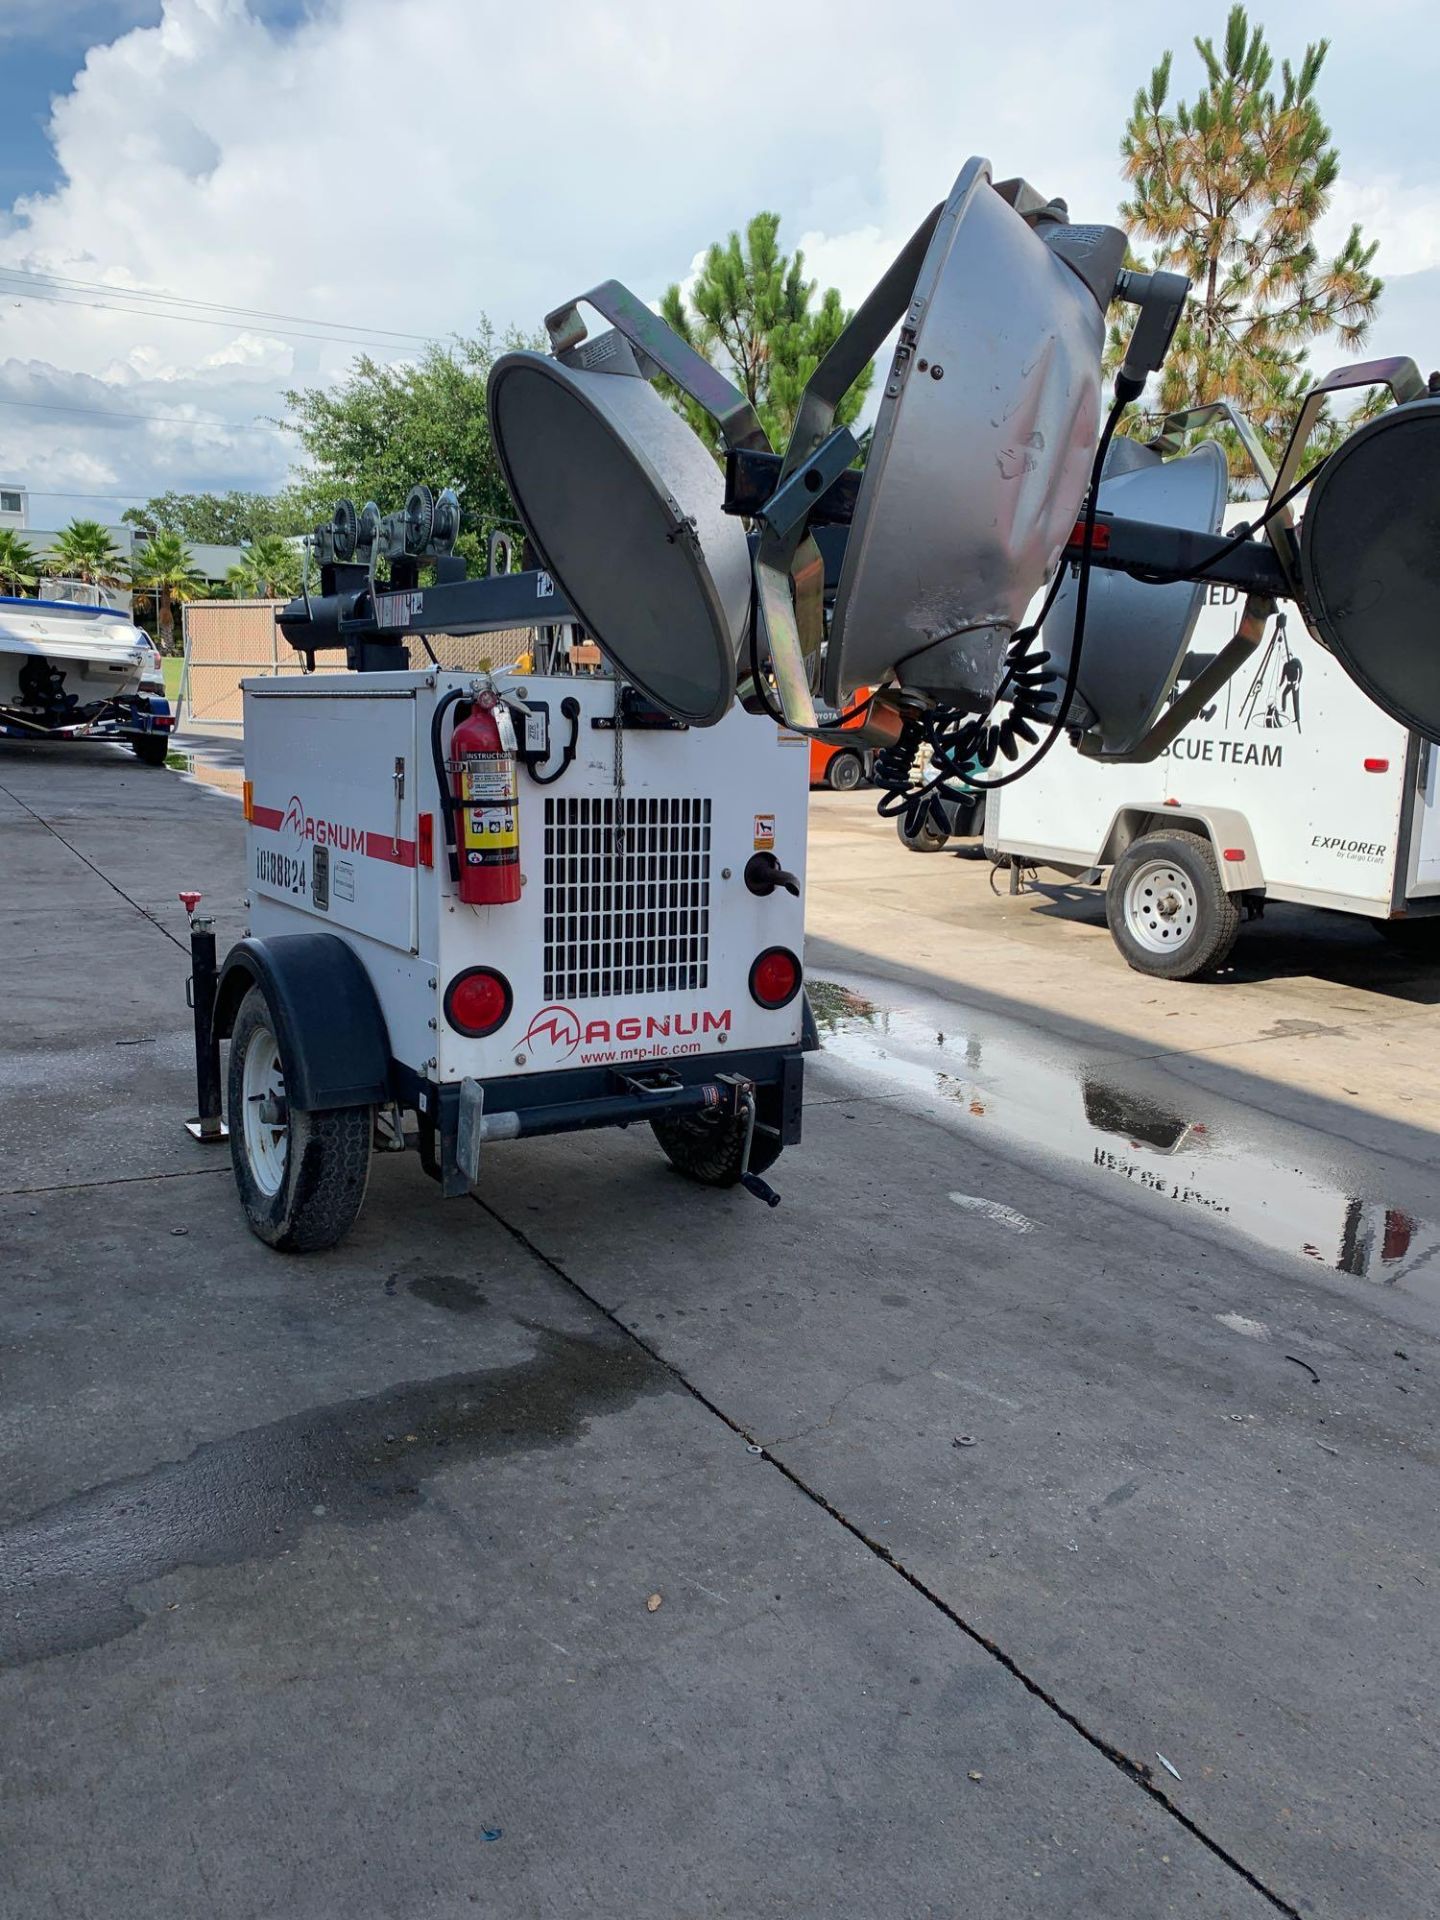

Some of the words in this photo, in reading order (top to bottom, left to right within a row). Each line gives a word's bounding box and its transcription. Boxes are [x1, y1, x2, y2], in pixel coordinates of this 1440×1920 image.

[1203, 584, 1239, 606] ED
[814, 712, 838, 721] OYOTA
[1159, 738, 1214, 762] SCUE
[1219, 740, 1282, 767] TEAM
[283, 796, 365, 855] MAGNUM
[1311, 835, 1386, 857] EXPLORER
[512, 1005, 731, 1062] MAGNUM
